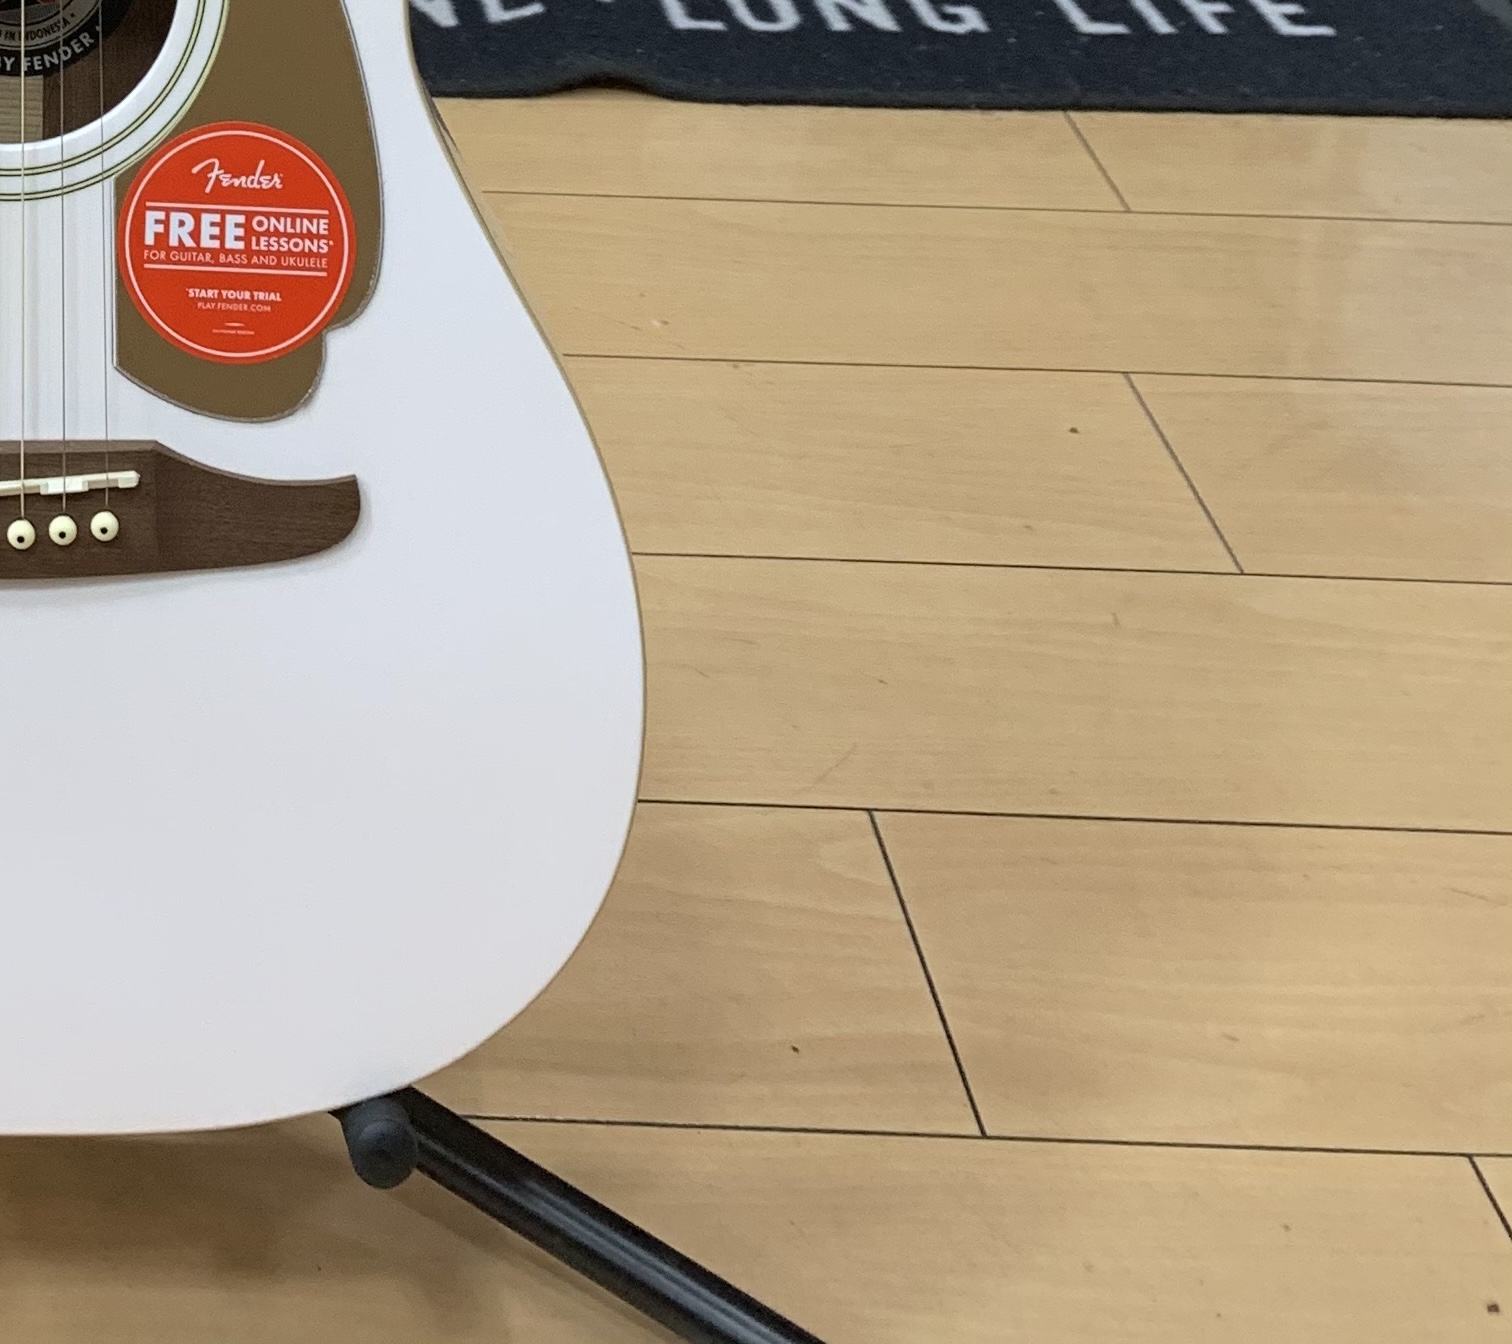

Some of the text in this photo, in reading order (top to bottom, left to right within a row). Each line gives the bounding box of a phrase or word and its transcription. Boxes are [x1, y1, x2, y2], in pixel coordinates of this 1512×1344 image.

[23, 31, 95, 71] FENDER
[191, 158, 283, 193] Fender
[144, 209, 246, 250] FREE
[251, 215, 329, 235] ONLINE
[144, 249, 328, 269] FOR GUITAR, BASS AND UKULELE
[221, 289, 251, 301] YOUR
[253, 290, 282, 302] TRIAL
